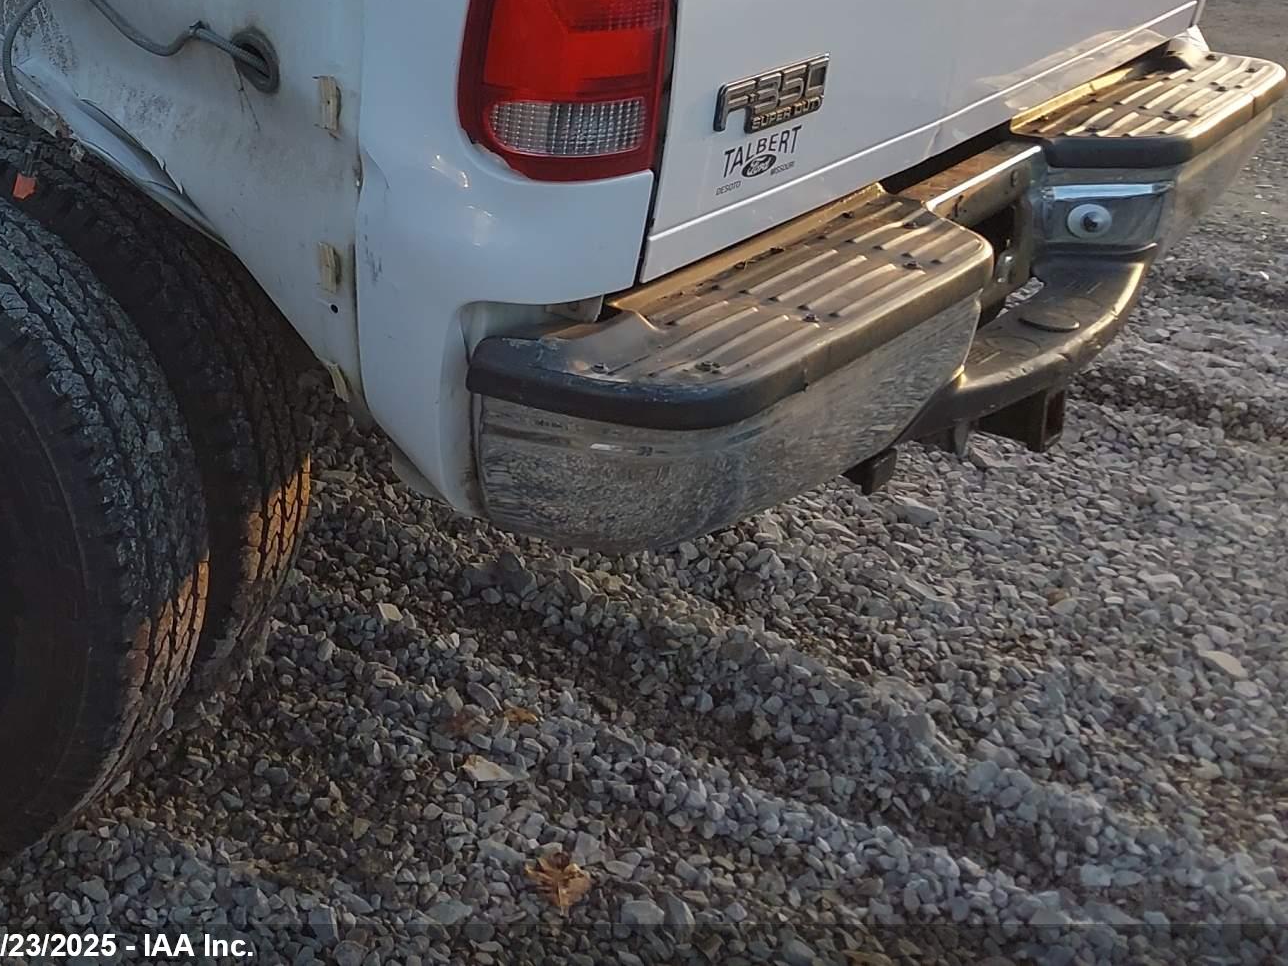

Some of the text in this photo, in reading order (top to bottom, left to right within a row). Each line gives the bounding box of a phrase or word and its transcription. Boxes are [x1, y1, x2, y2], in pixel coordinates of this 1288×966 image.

[751, 106, 793, 130] SUPER
[723, 125, 803, 178] TALBERT
[745, 155, 773, 176] Ford
[715, 180, 742, 195] DESOTO
